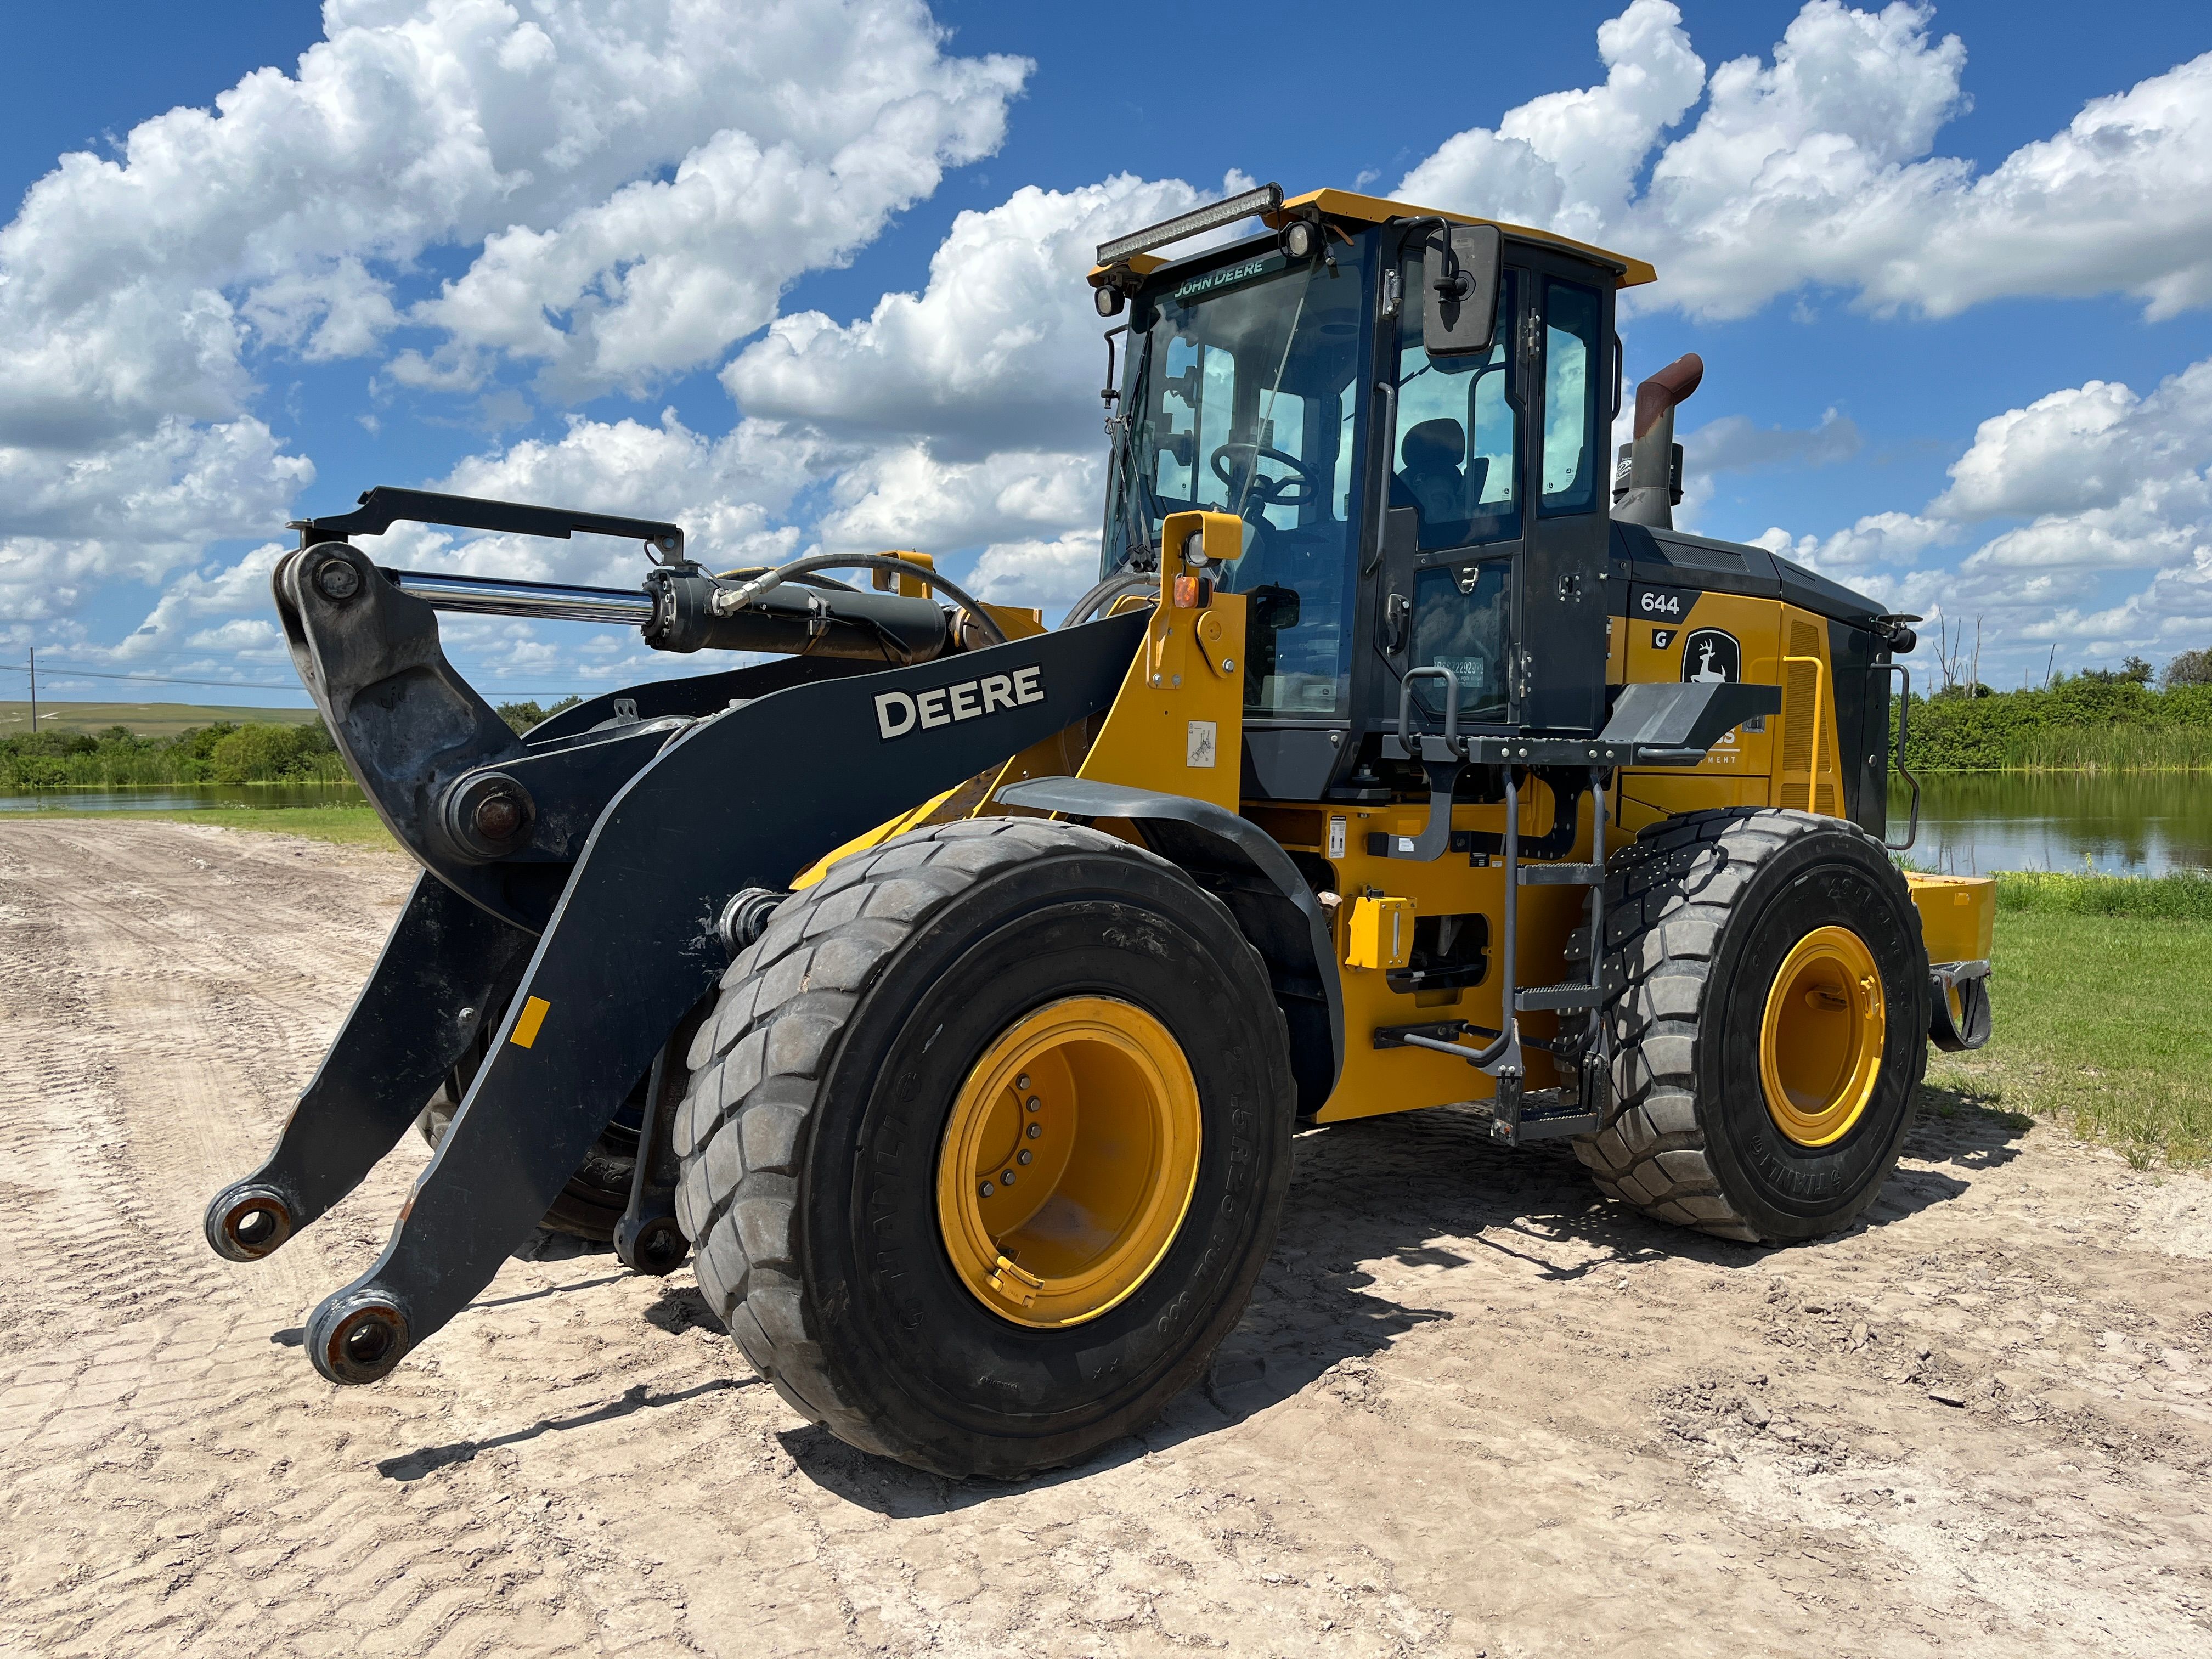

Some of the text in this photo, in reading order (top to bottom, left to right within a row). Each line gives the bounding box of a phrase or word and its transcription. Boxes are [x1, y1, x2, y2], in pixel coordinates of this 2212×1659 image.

[1175, 259, 1265, 298] JOHN DEERE
[1641, 592, 1679, 614] 644
[1656, 631, 1667, 647] G
[874, 665, 1045, 740] DEERE
